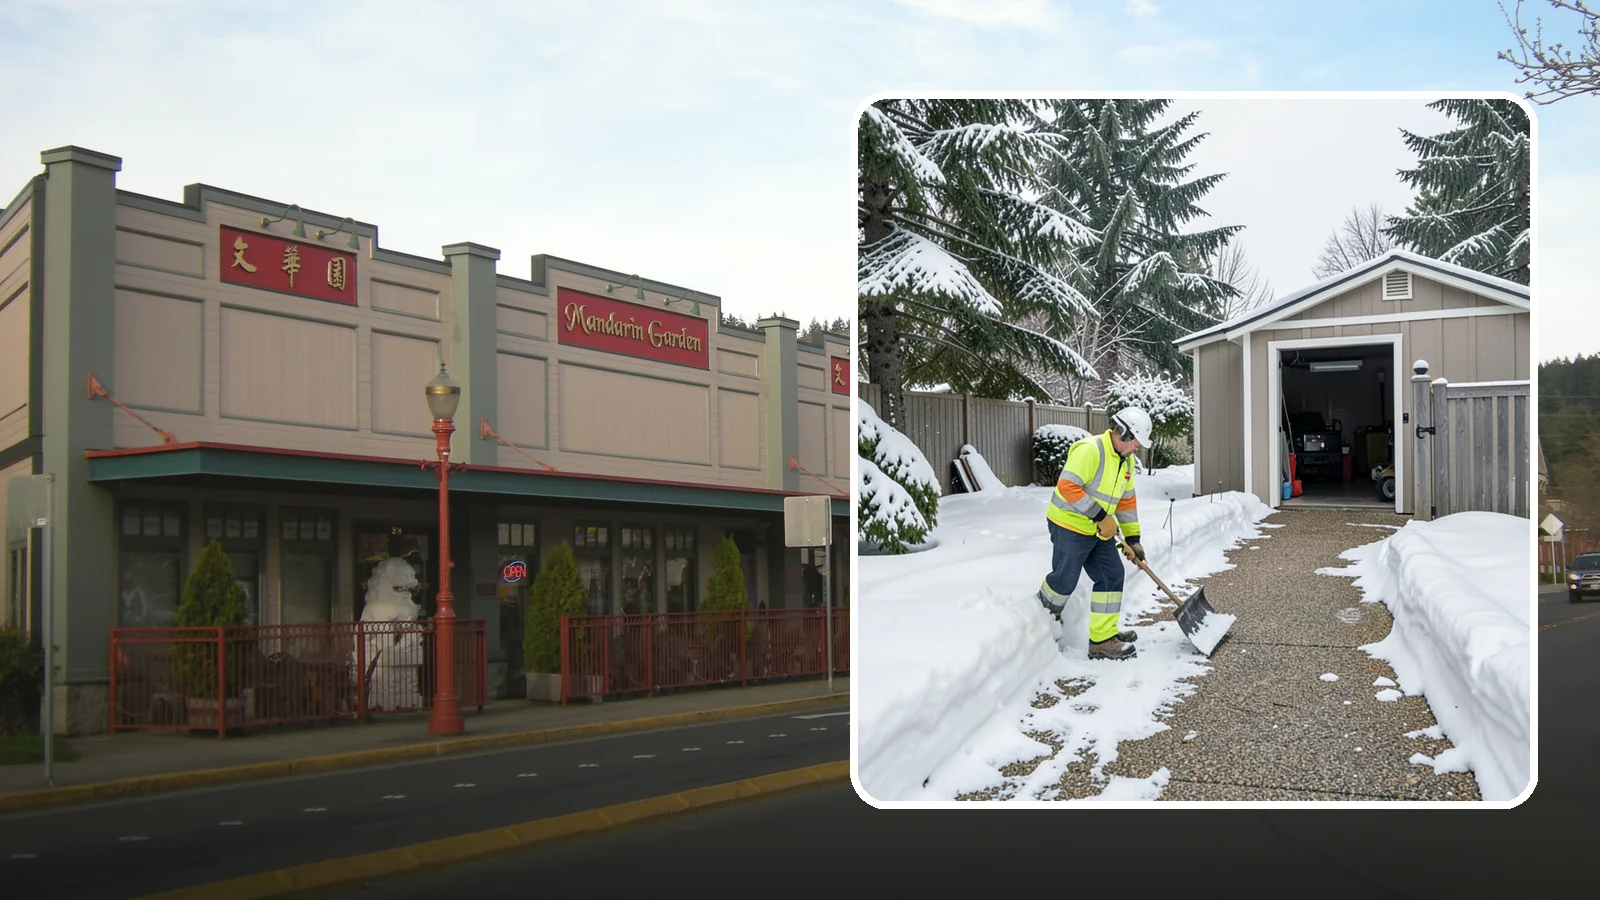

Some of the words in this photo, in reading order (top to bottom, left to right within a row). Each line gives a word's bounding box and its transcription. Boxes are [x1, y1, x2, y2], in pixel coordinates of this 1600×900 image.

[231, 236, 347, 291] 文華園
[564, 302, 644, 341] Mandarin
[648, 320, 702, 353] Garden
[835, 363, 846, 386] 文
[503, 565, 527, 578] OPEN
